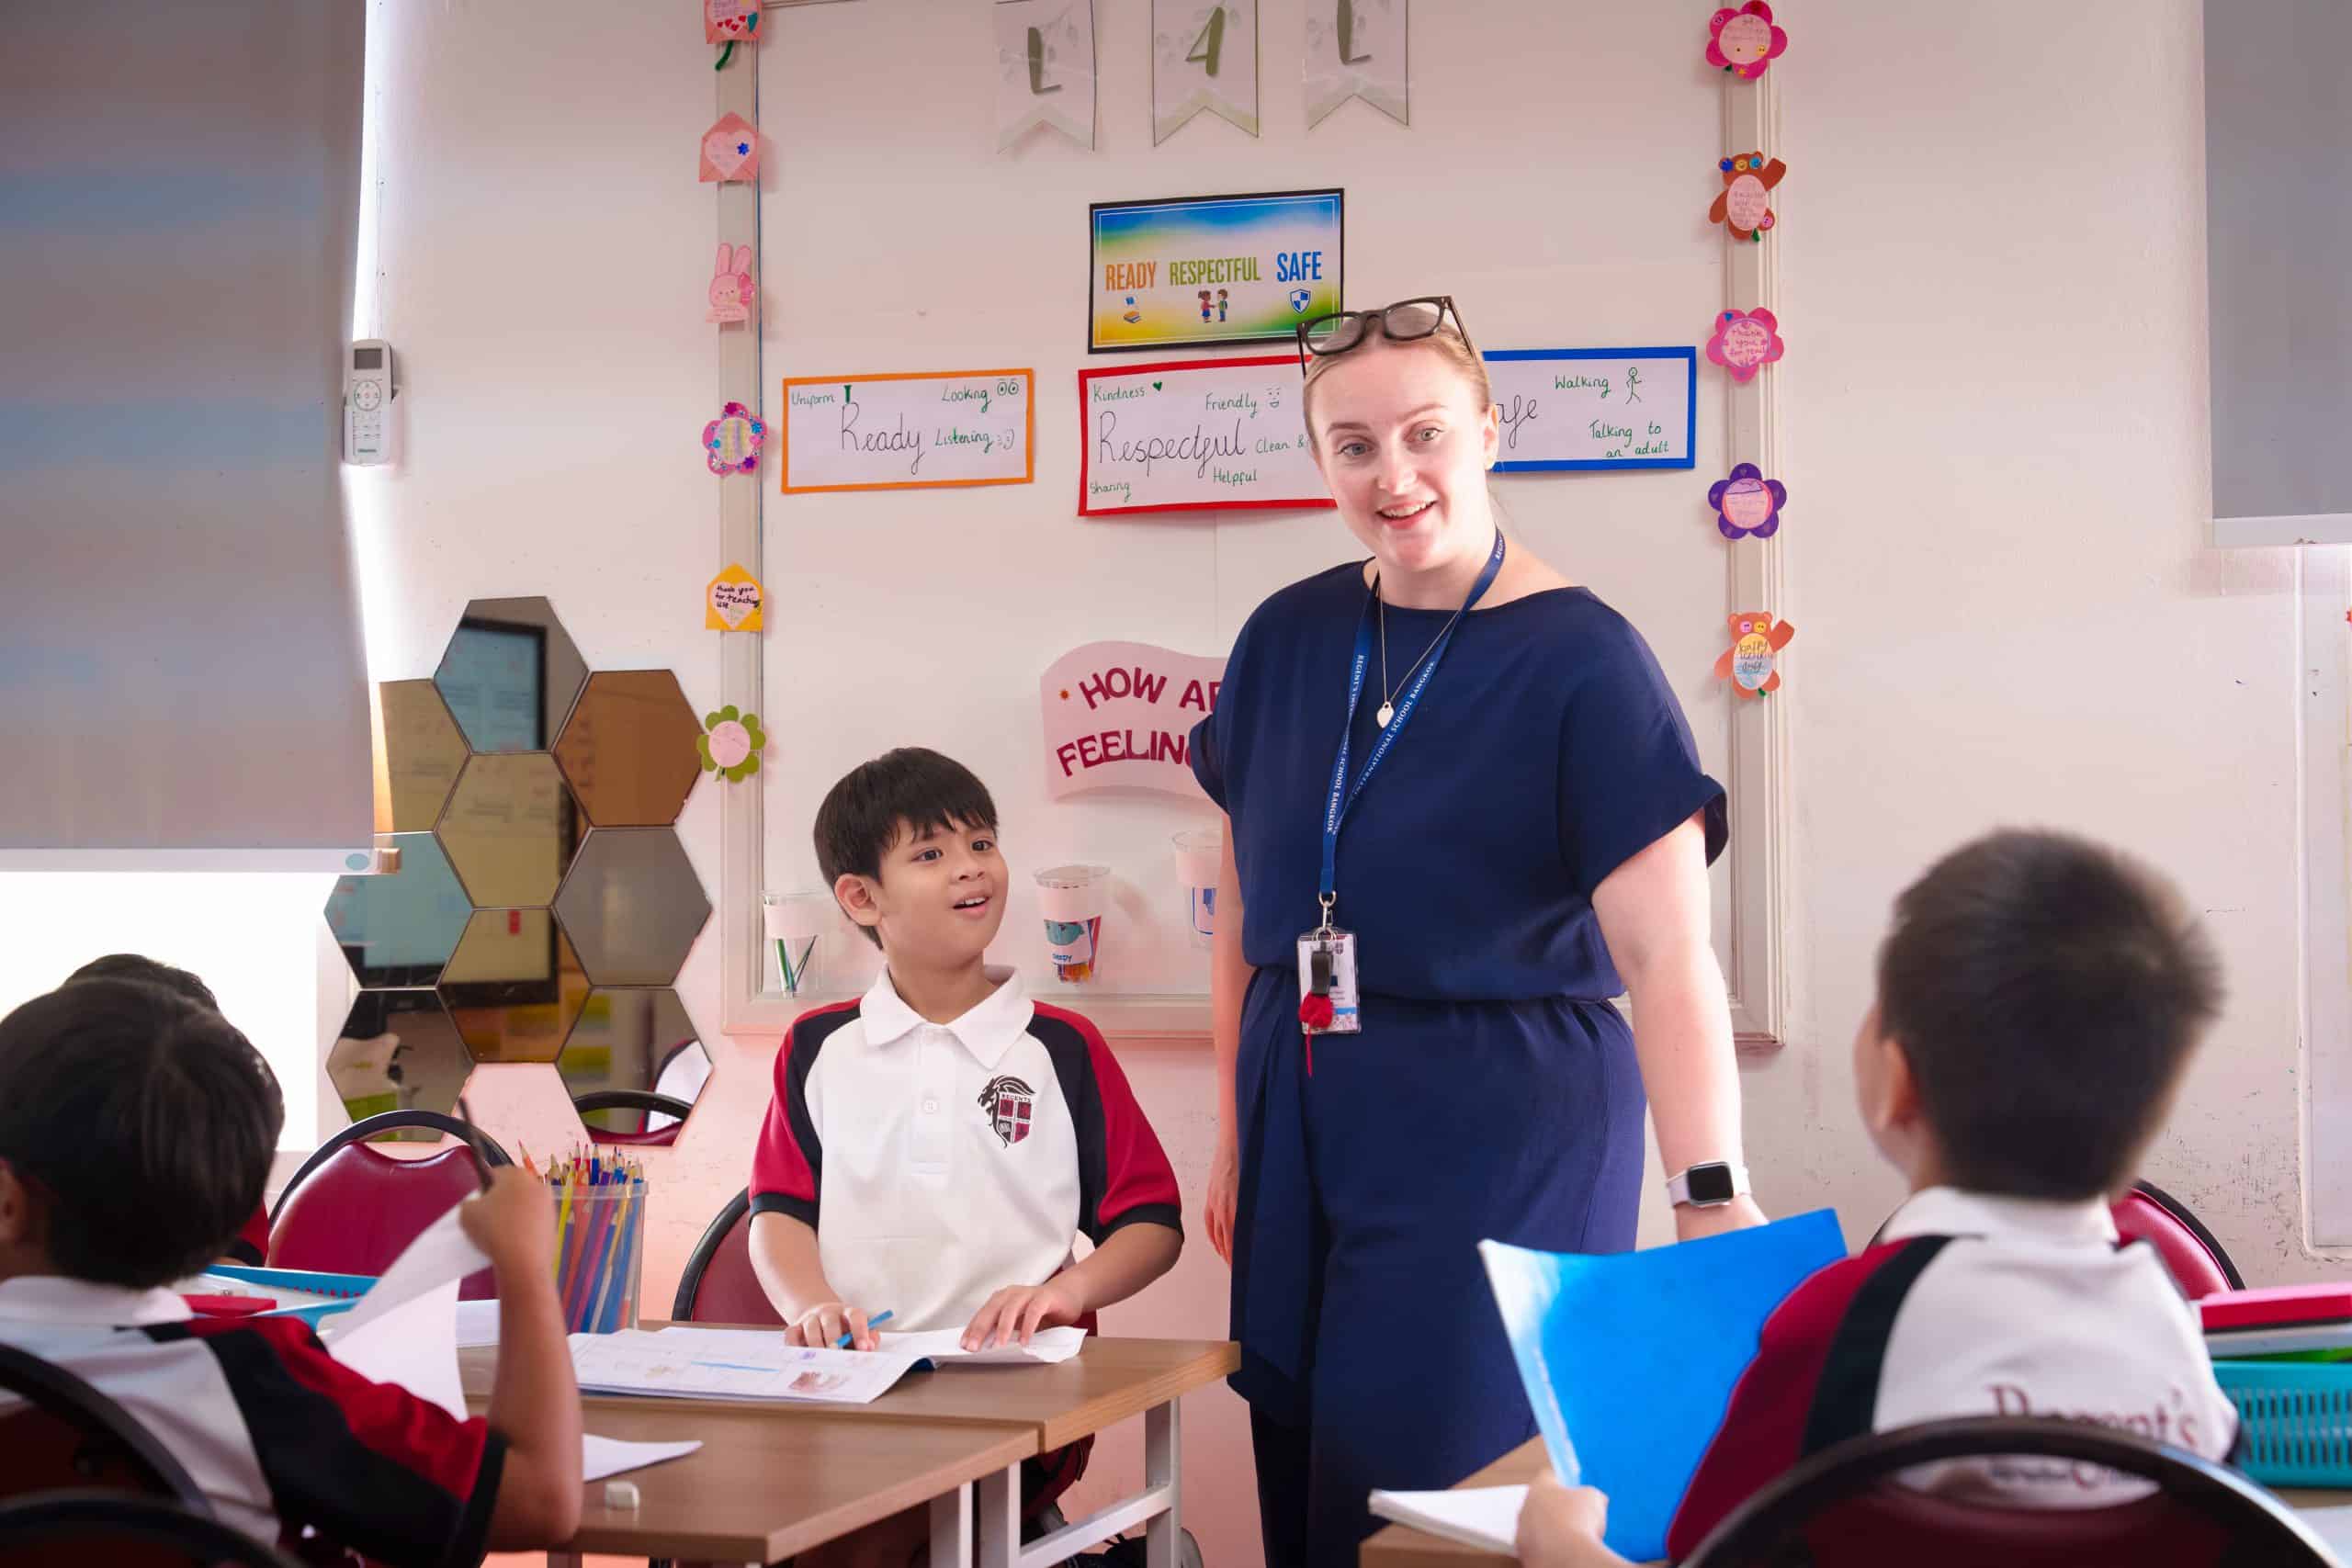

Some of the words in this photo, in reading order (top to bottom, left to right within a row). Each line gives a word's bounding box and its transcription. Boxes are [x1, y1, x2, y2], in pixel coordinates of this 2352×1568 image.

[1105, 261, 1158, 291] READY
[1169, 256, 1262, 287] RESPECTFUL
[1276, 251, 1323, 283] SAFE
[791, 391, 835, 409] Uniform
[942, 386, 991, 412] Looking
[1093, 383, 1145, 403] Kindness
[1555, 375, 1611, 399] Walking
[1205, 392, 1257, 418] Friendly
[1496, 395, 1539, 449] afe
[1589, 419, 1633, 448] Talking
[1647, 421, 1662, 434] to
[842, 401, 925, 475] Ready
[934, 428, 994, 453] Listening
[1100, 411, 1246, 479] Respectful
[1256, 435, 1290, 454] Clean
[1606, 446, 1623, 457] an
[1634, 441, 1668, 456] adult
[1213, 467, 1257, 485] Helpful
[1078, 666, 1168, 710] HOW
[1391, 700, 1412, 733] SCHOOL
[1057, 729, 1193, 777] FEELIN
